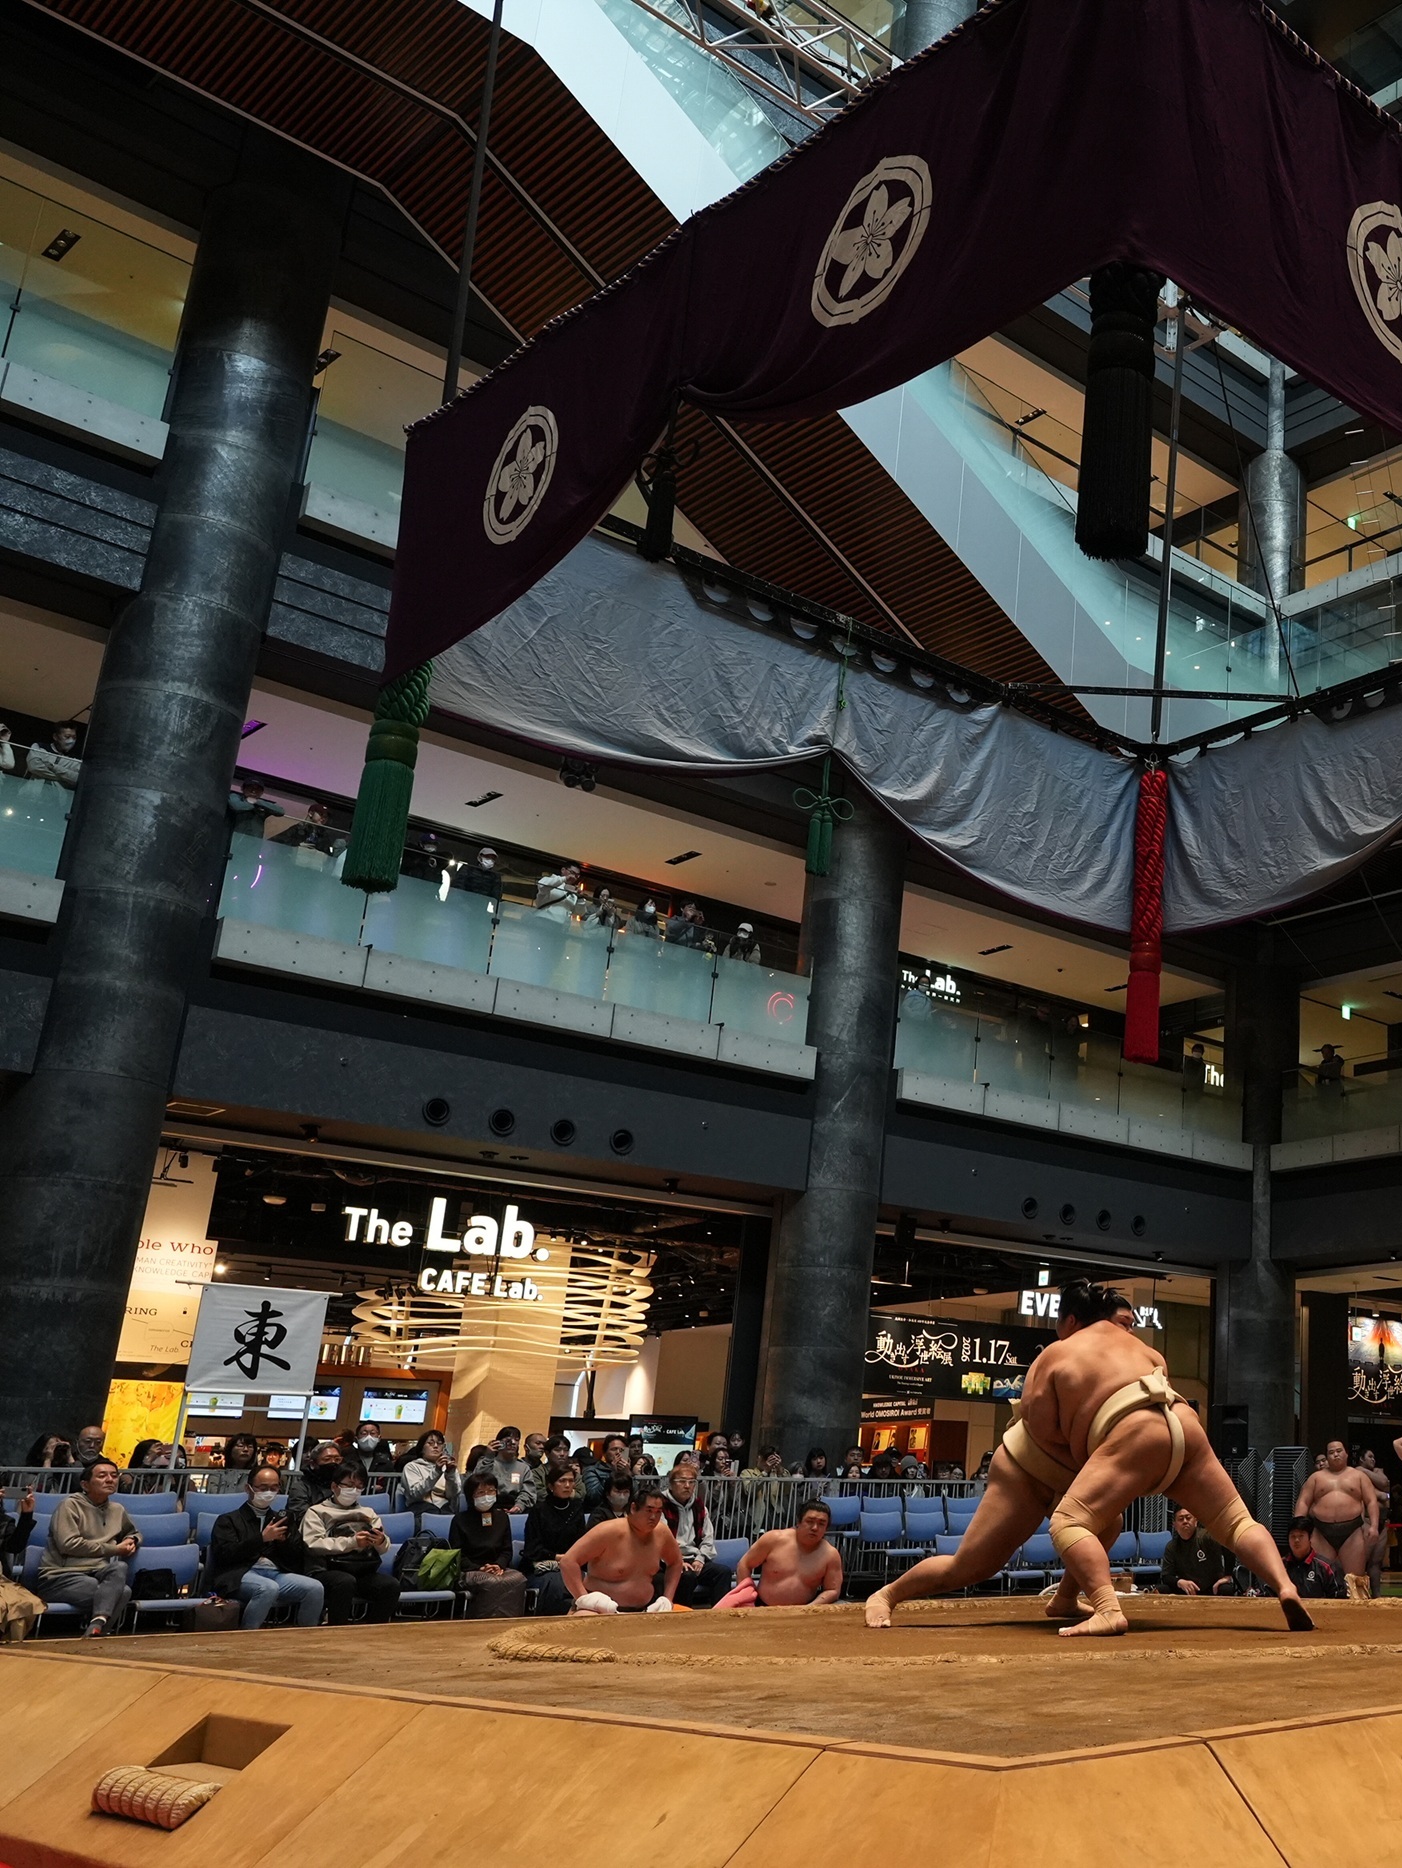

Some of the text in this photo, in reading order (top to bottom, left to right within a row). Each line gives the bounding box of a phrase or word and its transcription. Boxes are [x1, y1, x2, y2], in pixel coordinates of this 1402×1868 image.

[902, 969, 919, 984] Th
[343, 1197, 551, 1262] The Lab.
[170, 1241, 214, 1255] Who
[419, 1267, 544, 1301] CAFE Lab.
[223, 1300, 291, 1381] 東
[961, 1336, 971, 1363] 2026
[972, 1337, 1018, 1365] 1.17 Sat
